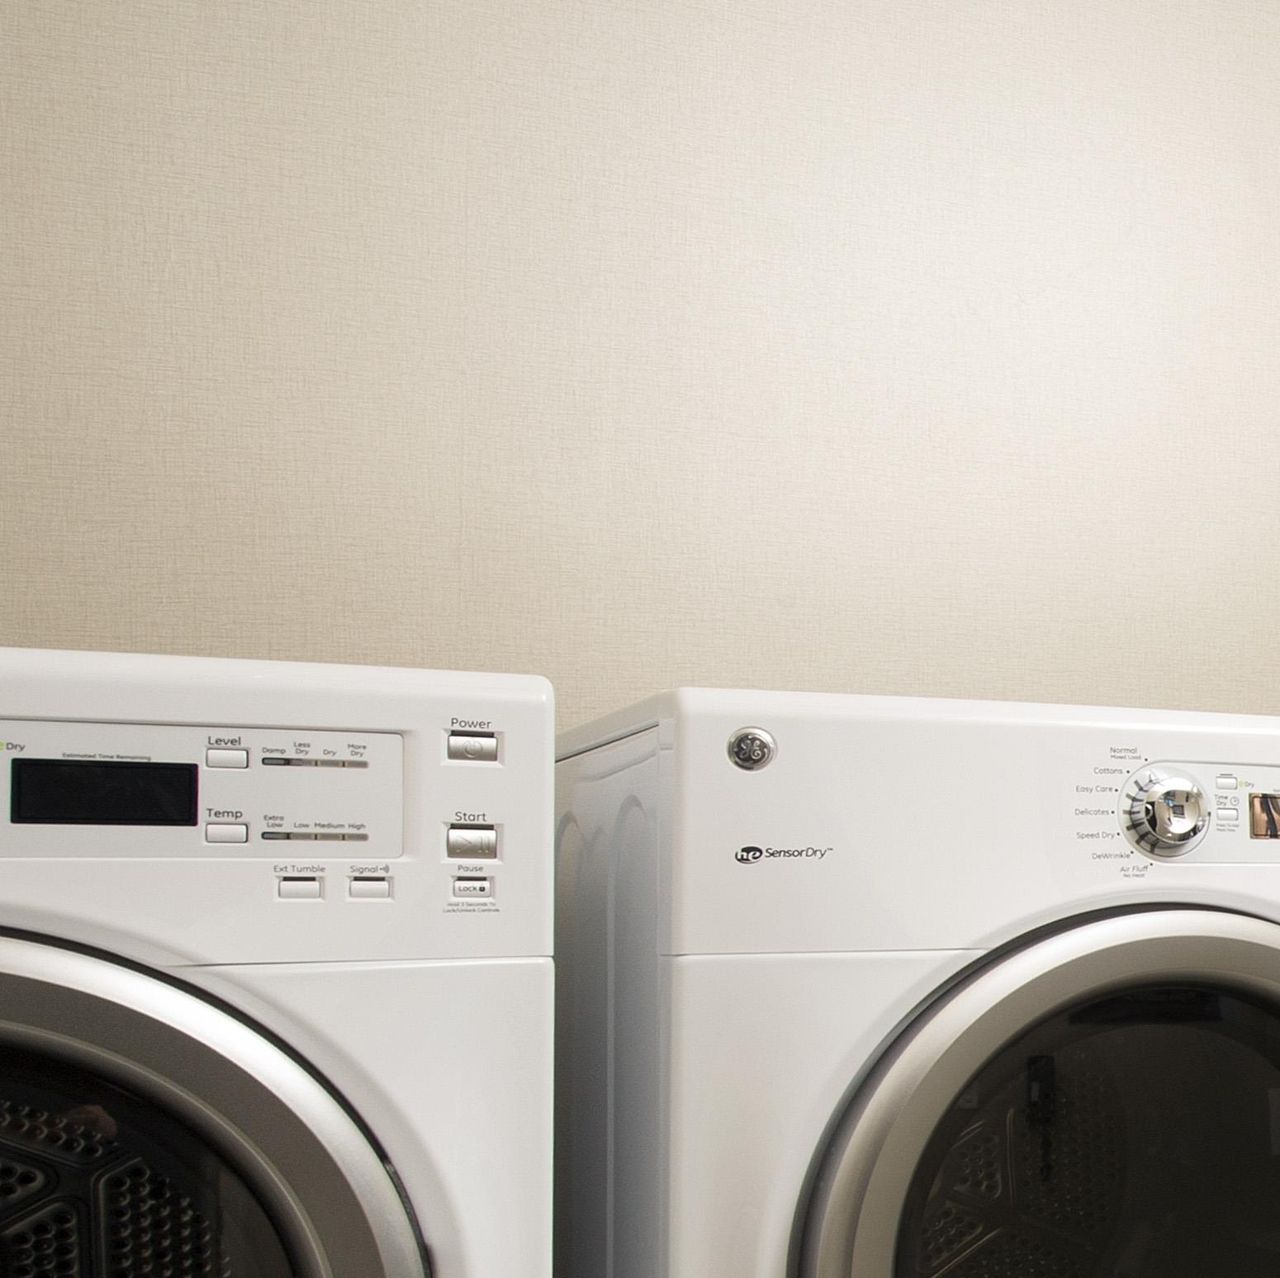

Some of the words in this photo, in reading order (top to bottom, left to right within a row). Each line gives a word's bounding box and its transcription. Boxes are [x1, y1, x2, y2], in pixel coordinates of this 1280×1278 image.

[450, 717, 491, 729] Power
[207, 736, 242, 746] Level
[262, 747, 286, 755] Damp
[296, 748, 309, 756] Dry
[323, 749, 337, 757] Dry
[350, 750, 364, 758] Dry
[207, 808, 243, 819] Temp
[455, 811, 487, 822] Start
[1076, 832, 1100, 840] Speed
[273, 865, 288, 873] Ext
[290, 865, 326, 873] Tumble
[350, 865, 379, 874] Signal
[457, 864, 484, 872] Pause
